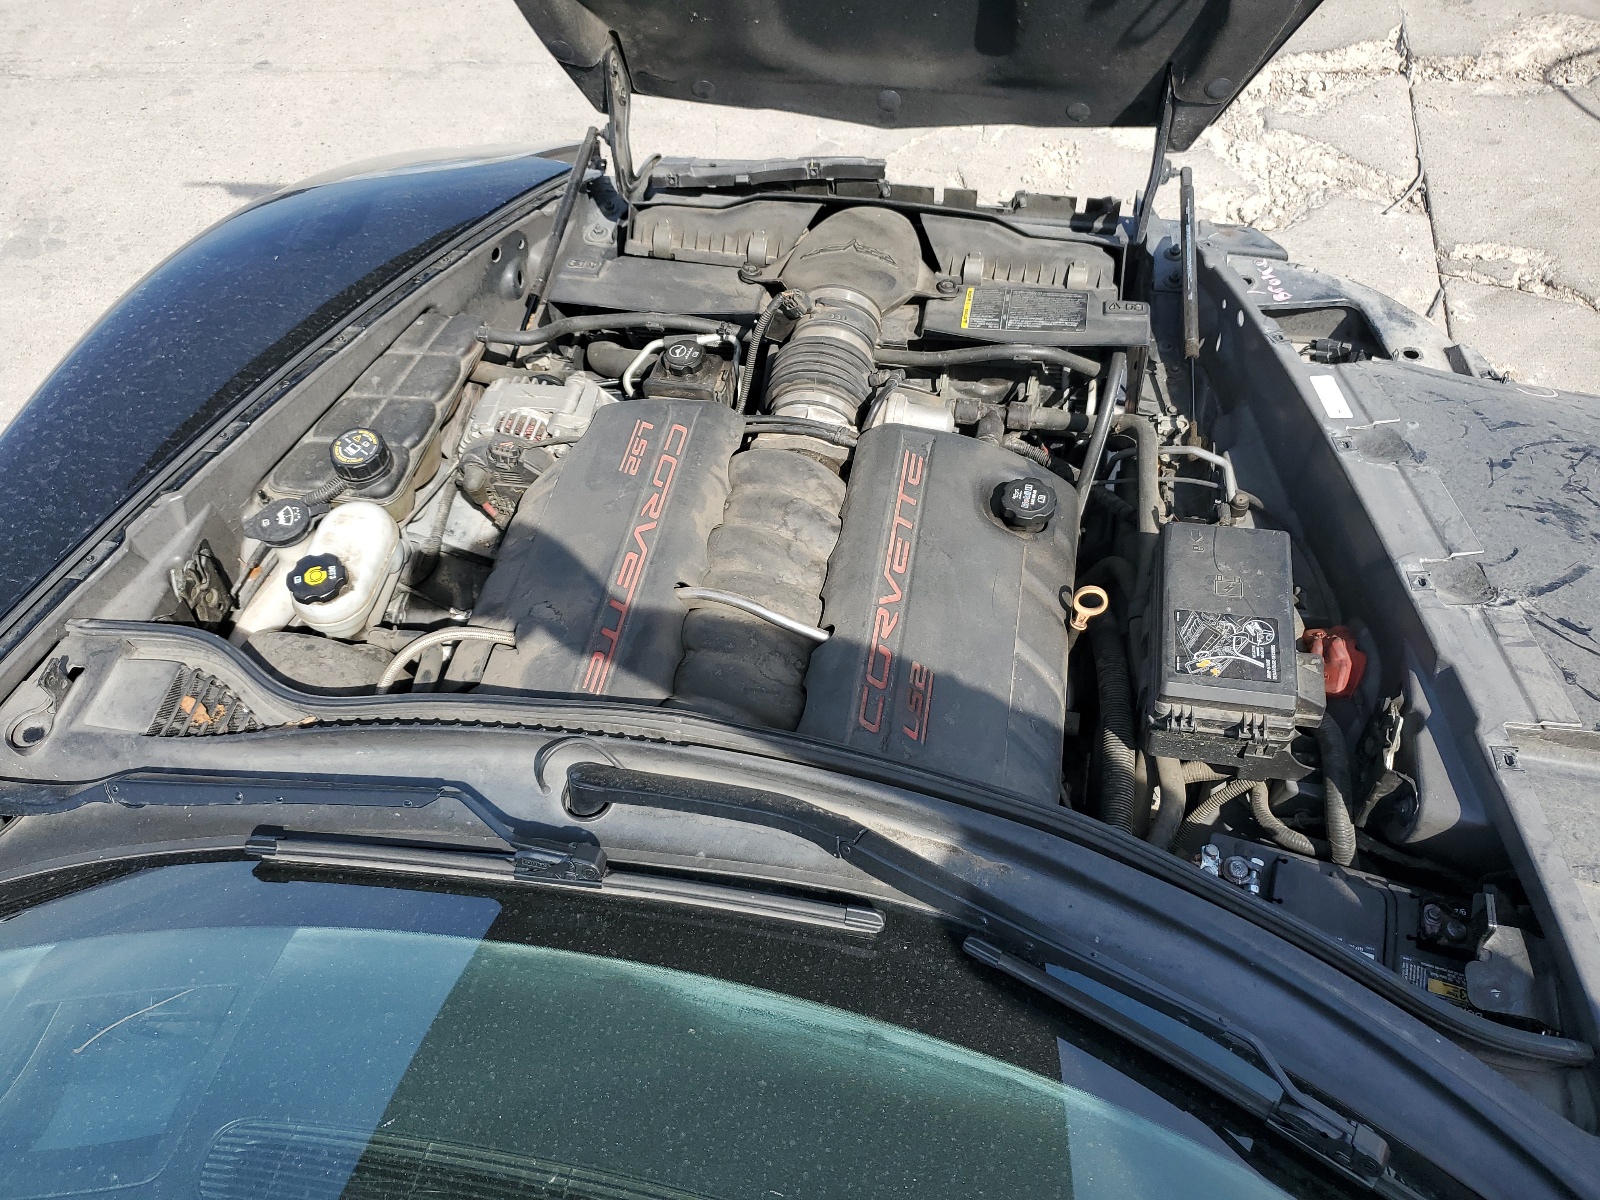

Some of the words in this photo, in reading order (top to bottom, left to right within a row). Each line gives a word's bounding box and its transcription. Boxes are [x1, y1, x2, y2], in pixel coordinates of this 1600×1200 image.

[621, 419, 654, 476] LS2
[583, 423, 688, 695] CORVETTE
[858, 448, 924, 734] CORVETTE
[903, 660, 932, 743] LS2
